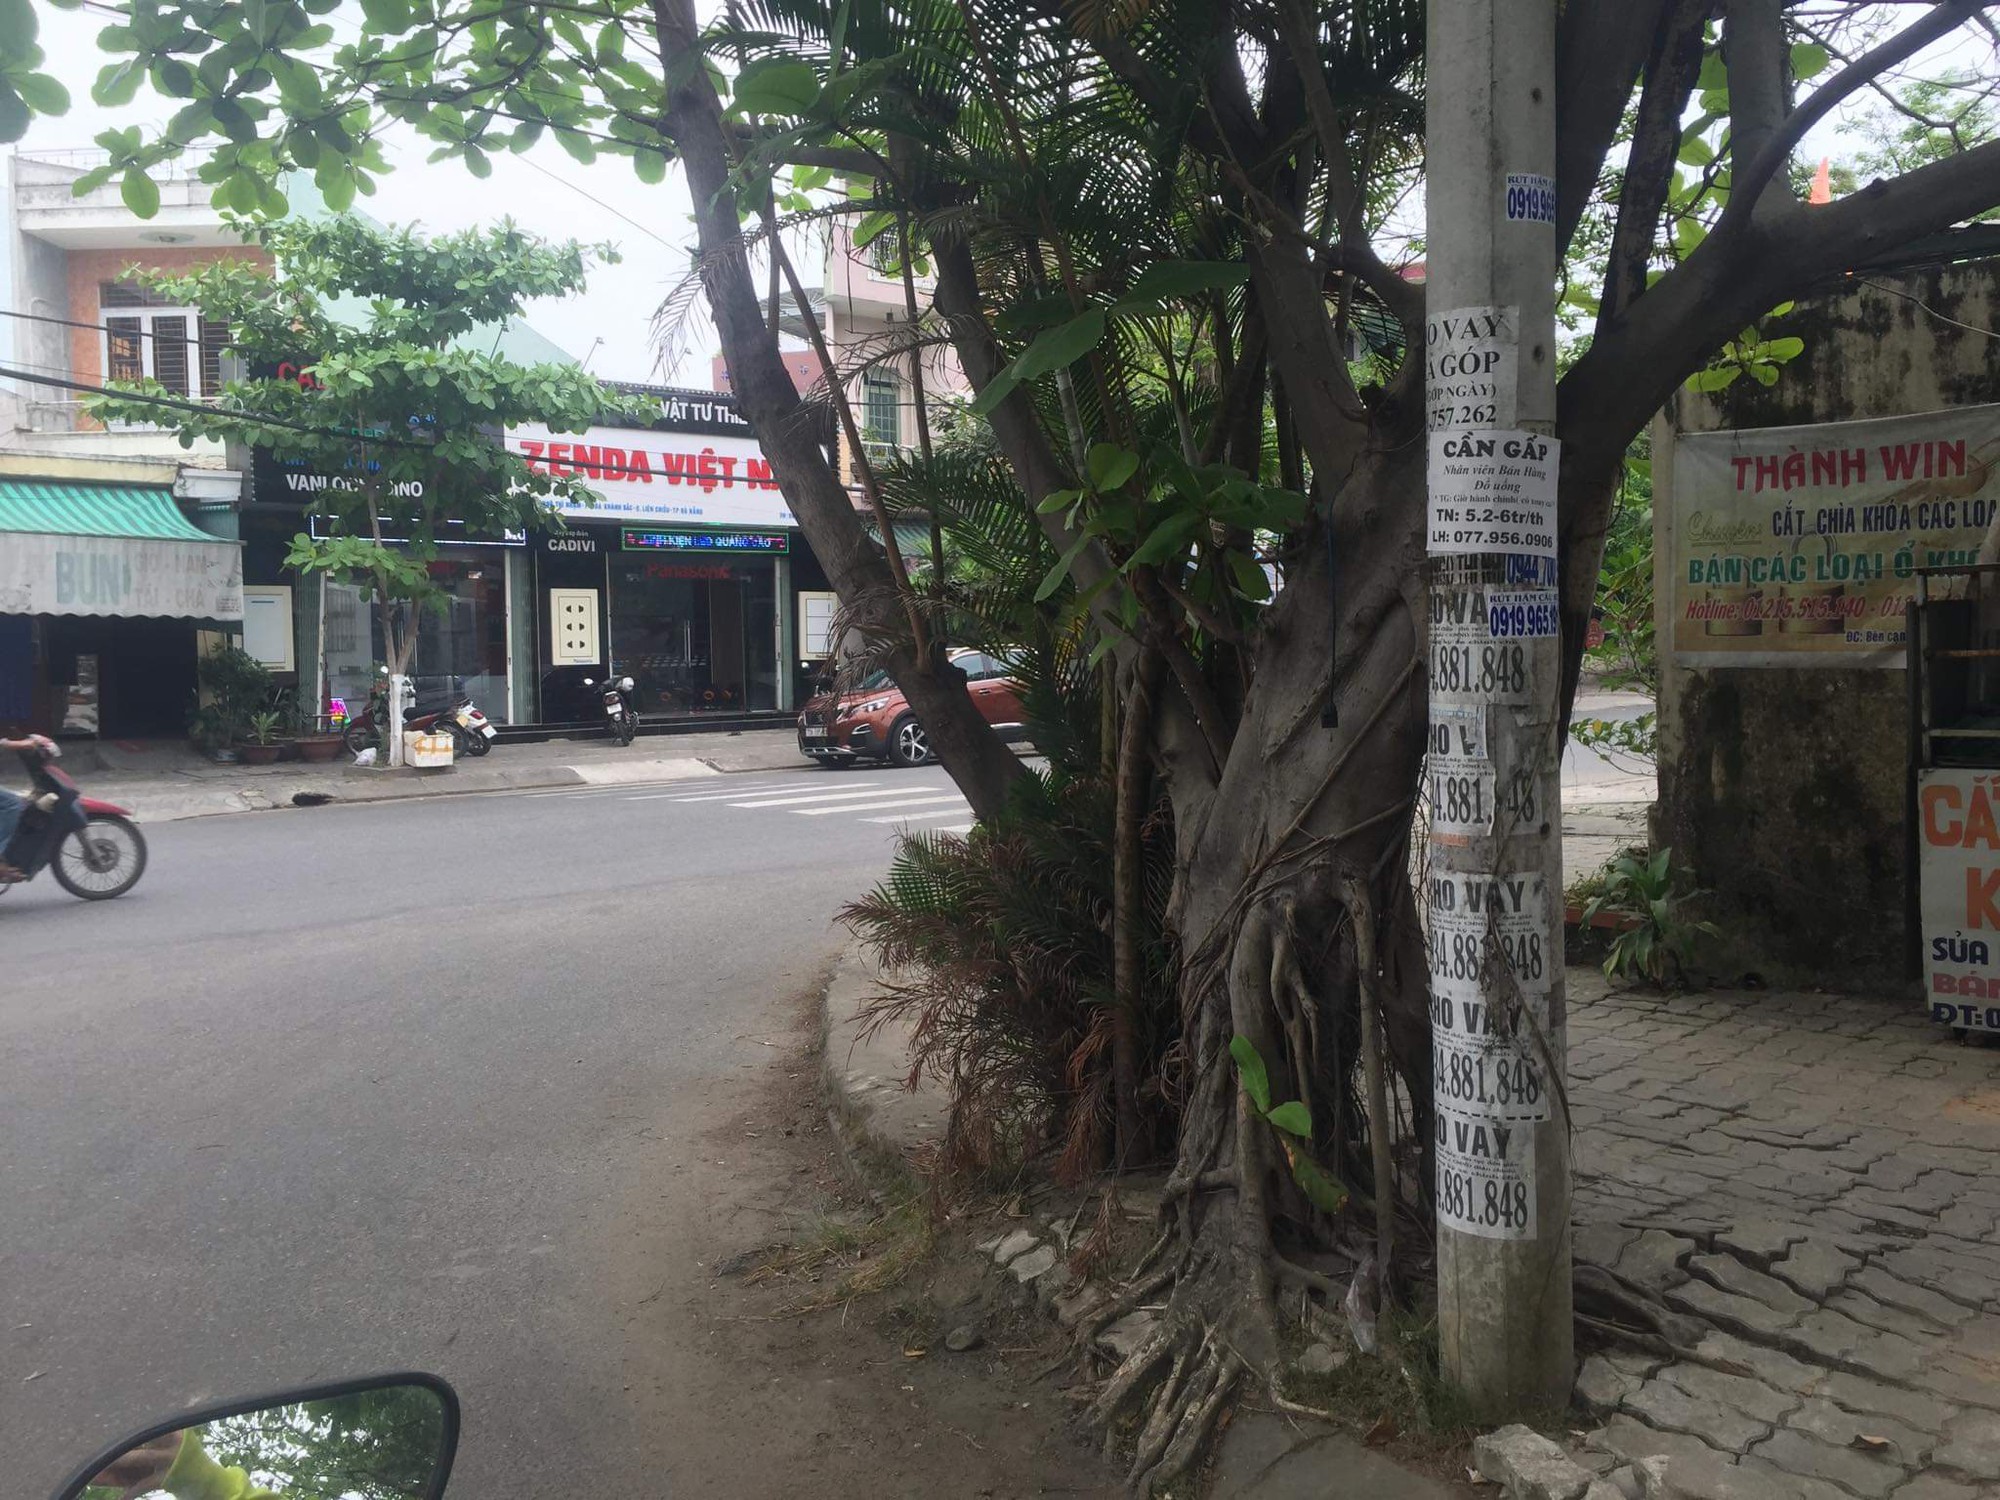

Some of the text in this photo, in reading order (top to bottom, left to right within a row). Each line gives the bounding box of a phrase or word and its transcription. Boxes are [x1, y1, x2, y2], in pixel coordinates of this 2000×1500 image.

[1442, 314, 1503, 341] VAY
[1440, 345, 1500, 377] GÓP
[1446, 381, 1497, 398] NGÀY)
[1443, 431, 1548, 461] CẦN GẤP
[520, 441, 653, 483] ZENDA
[663, 448, 738, 494] VIỆT
[1444, 464, 1547, 481] Nhân viên Bán Hàng
[1731, 439, 1966, 494] THÀNH WIN
[1436, 508, 1544, 526] TN: 5.2-6tr/th
[1772, 500, 1804, 537] CẮT
[1816, 502, 1856, 537] CHÌA
[1862, 499, 1912, 533] KHÓA
[1917, 496, 1956, 530] CÁC
[548, 539, 595, 552] CADIVI
[1432, 530, 1553, 548] LH: 077.956.0906
[1688, 553, 1742, 583] BÁN
[1751, 551, 1807, 583] CÁC
[1816, 553, 1882, 586] LOẠI
[1685, 600, 1740, 619] Hotline:
[1465, 880, 1525, 913] VAY
[1932, 930, 1989, 966] SỬA
[1454, 1120, 1513, 1160] VAY
